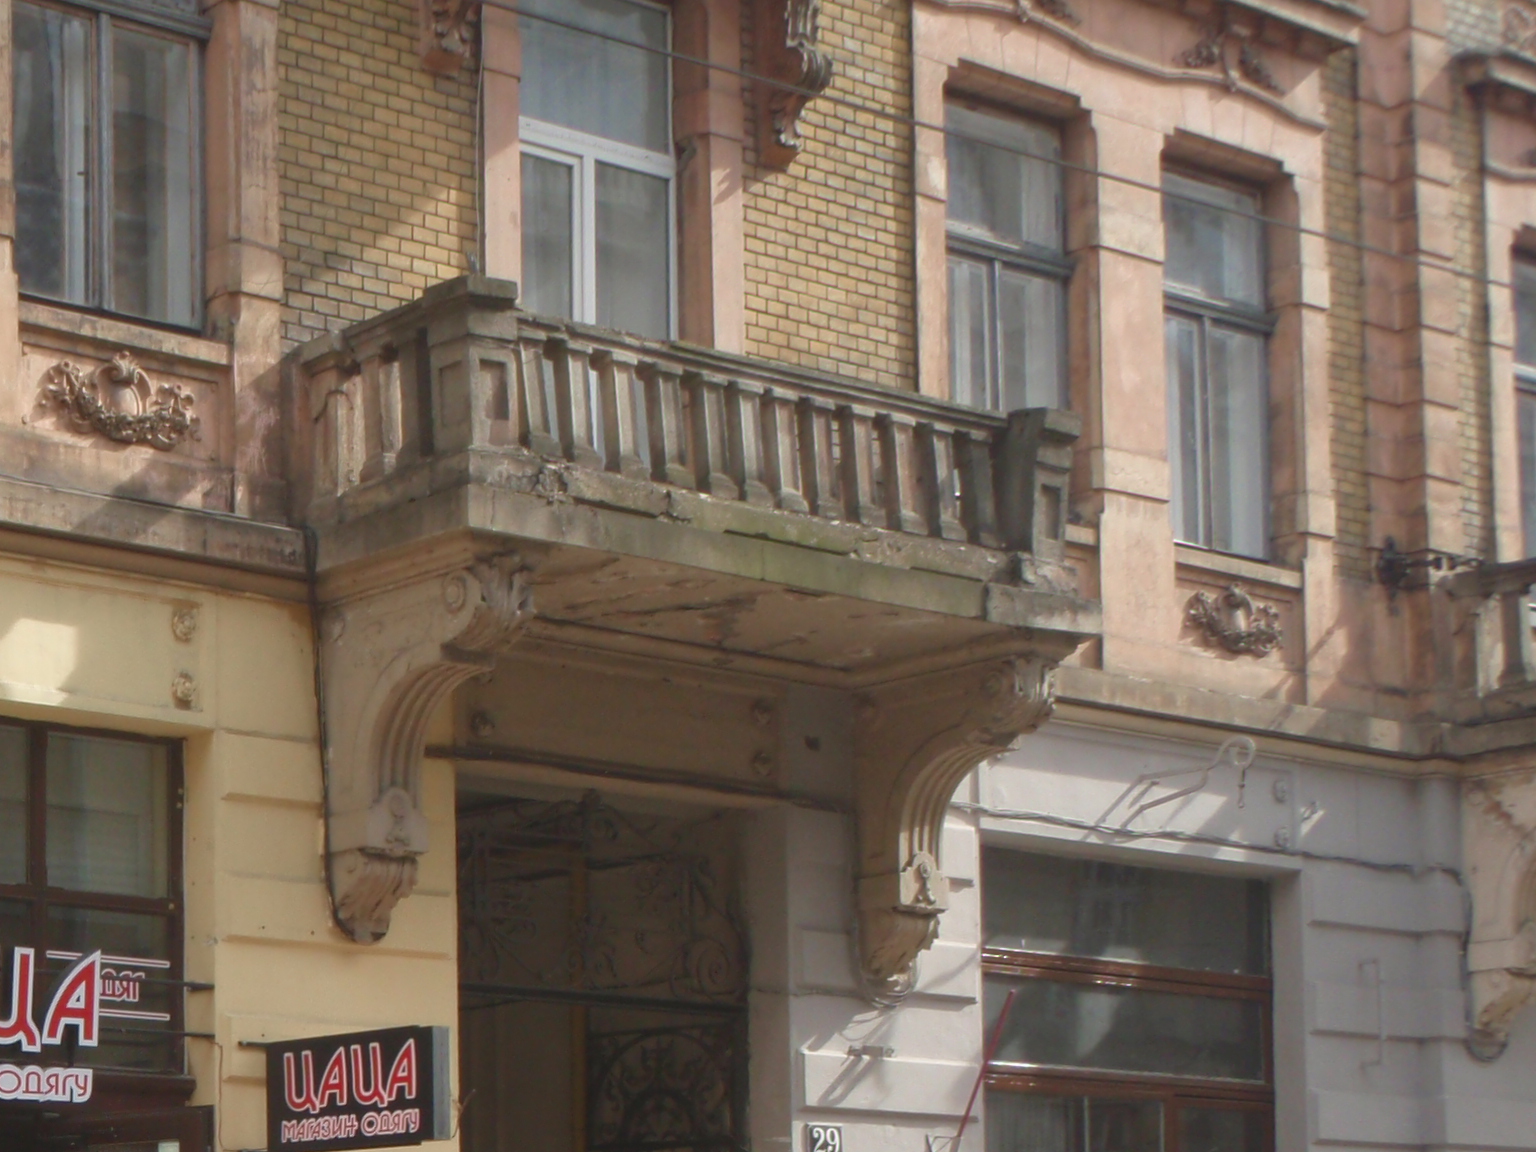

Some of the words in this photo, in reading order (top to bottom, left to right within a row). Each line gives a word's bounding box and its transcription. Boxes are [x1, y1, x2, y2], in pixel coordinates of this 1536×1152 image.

[283, 1038, 417, 1113] ЦАЦА
[281, 1114, 358, 1143] МАГАЗИН
[361, 1108, 420, 1137] ОДЯГУ
